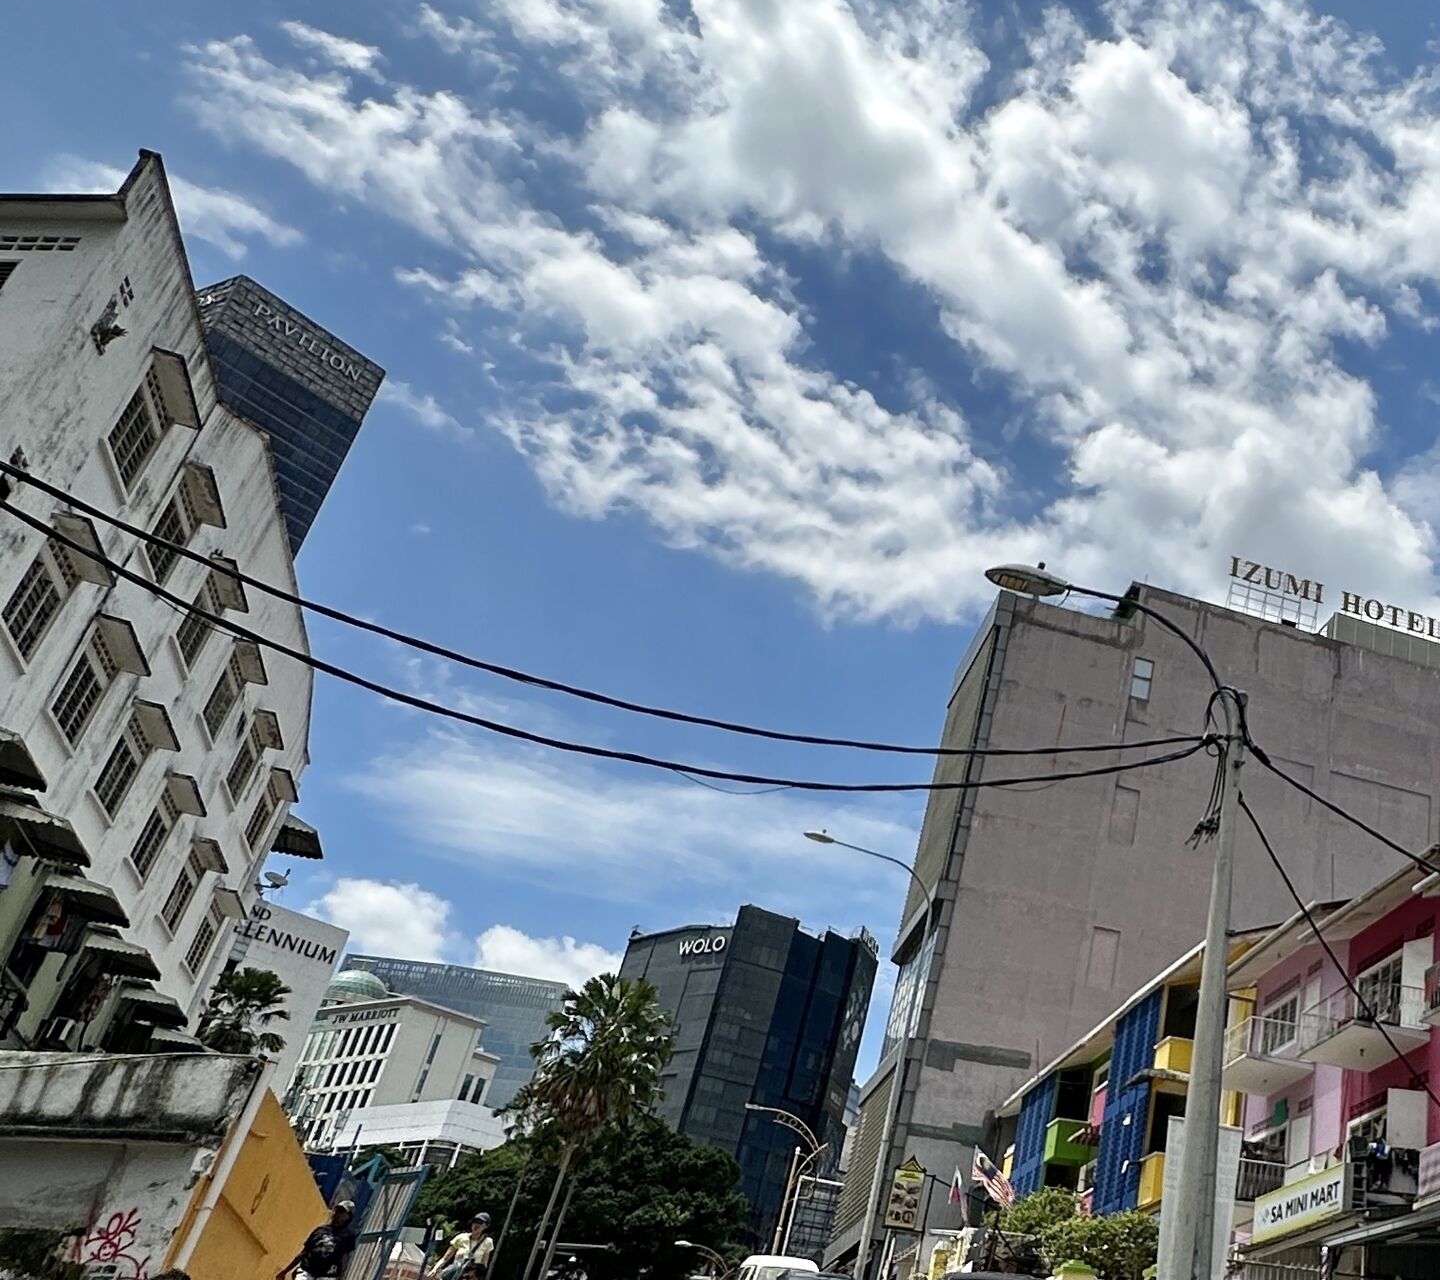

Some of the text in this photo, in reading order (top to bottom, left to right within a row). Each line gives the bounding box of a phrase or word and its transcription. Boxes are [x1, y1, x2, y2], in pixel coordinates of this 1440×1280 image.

[254, 303, 362, 381] PAVILION
[1228, 556, 1324, 604] IZUMI
[679, 936, 726, 956] WOLO
[332, 1008, 400, 1024] JW MARRIOTT
[1271, 1203, 1283, 1223] SA
[1285, 1193, 1308, 1218] MINI
[1310, 1181, 1340, 1208] MART
